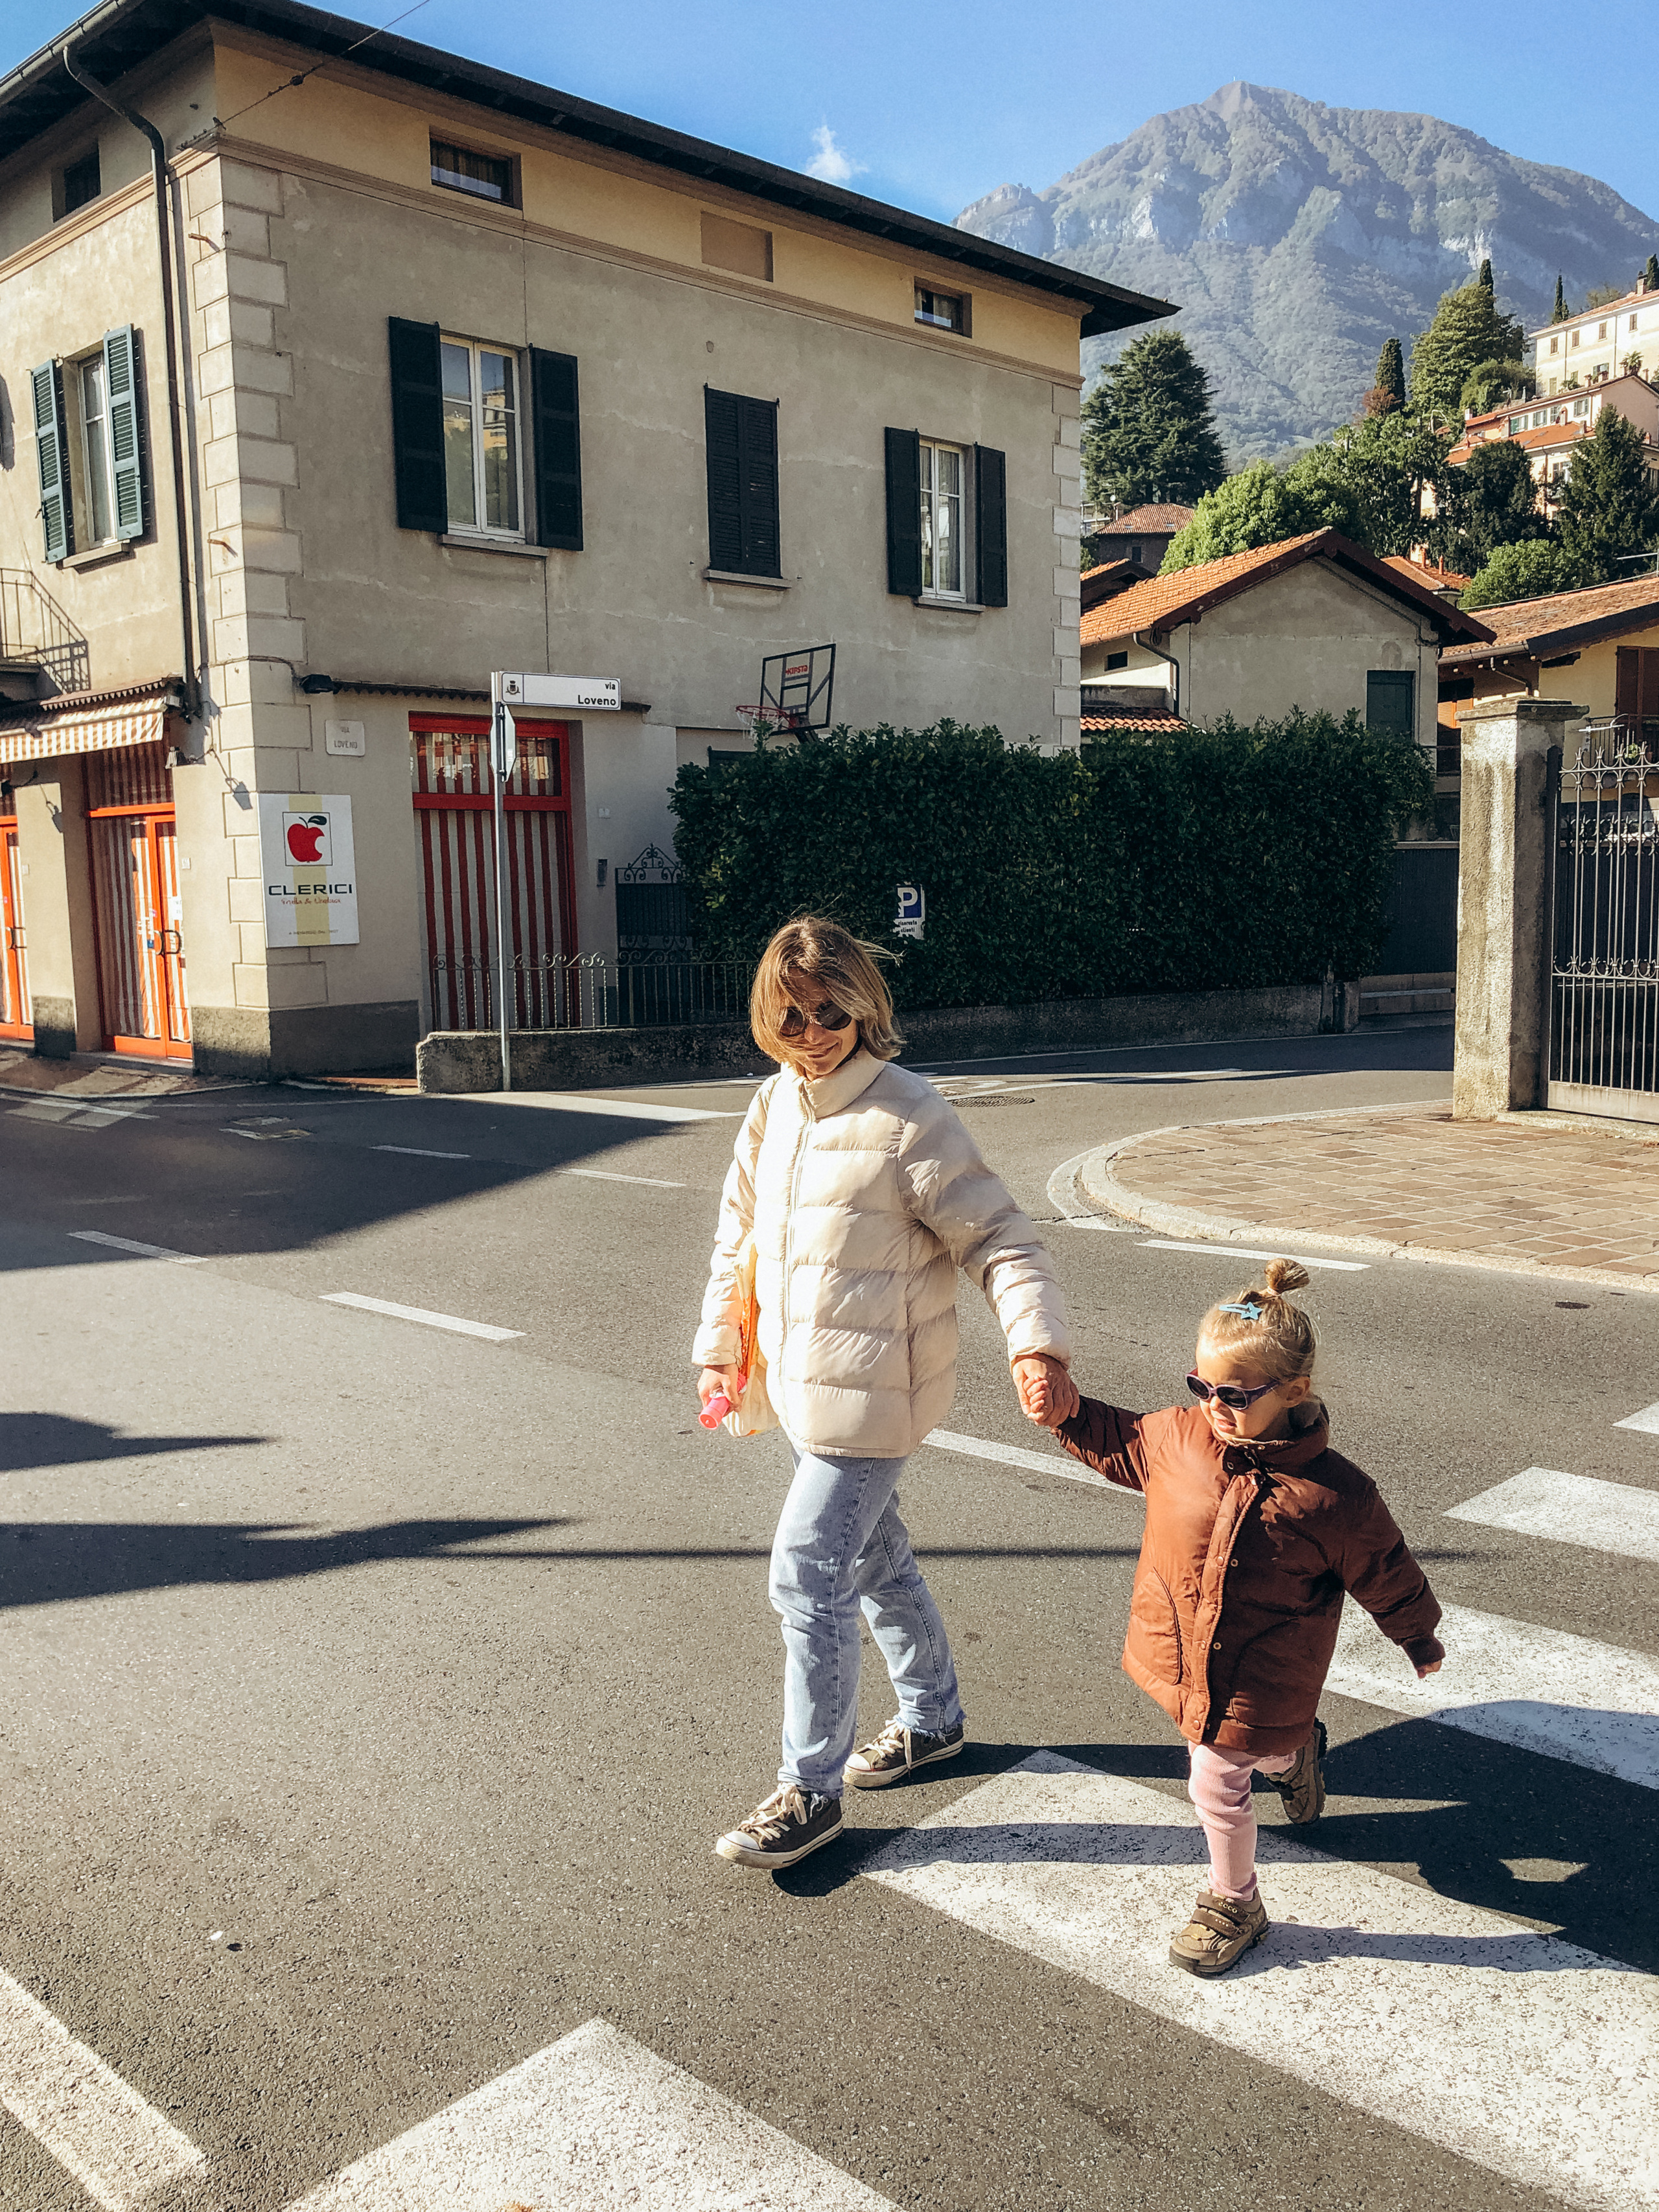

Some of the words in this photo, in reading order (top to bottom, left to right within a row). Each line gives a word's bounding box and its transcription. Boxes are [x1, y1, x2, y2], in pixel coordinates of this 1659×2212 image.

[578, 695, 616, 706] Loveno
[268, 884, 352, 895] CLERICI
[898, 887, 918, 917] P
